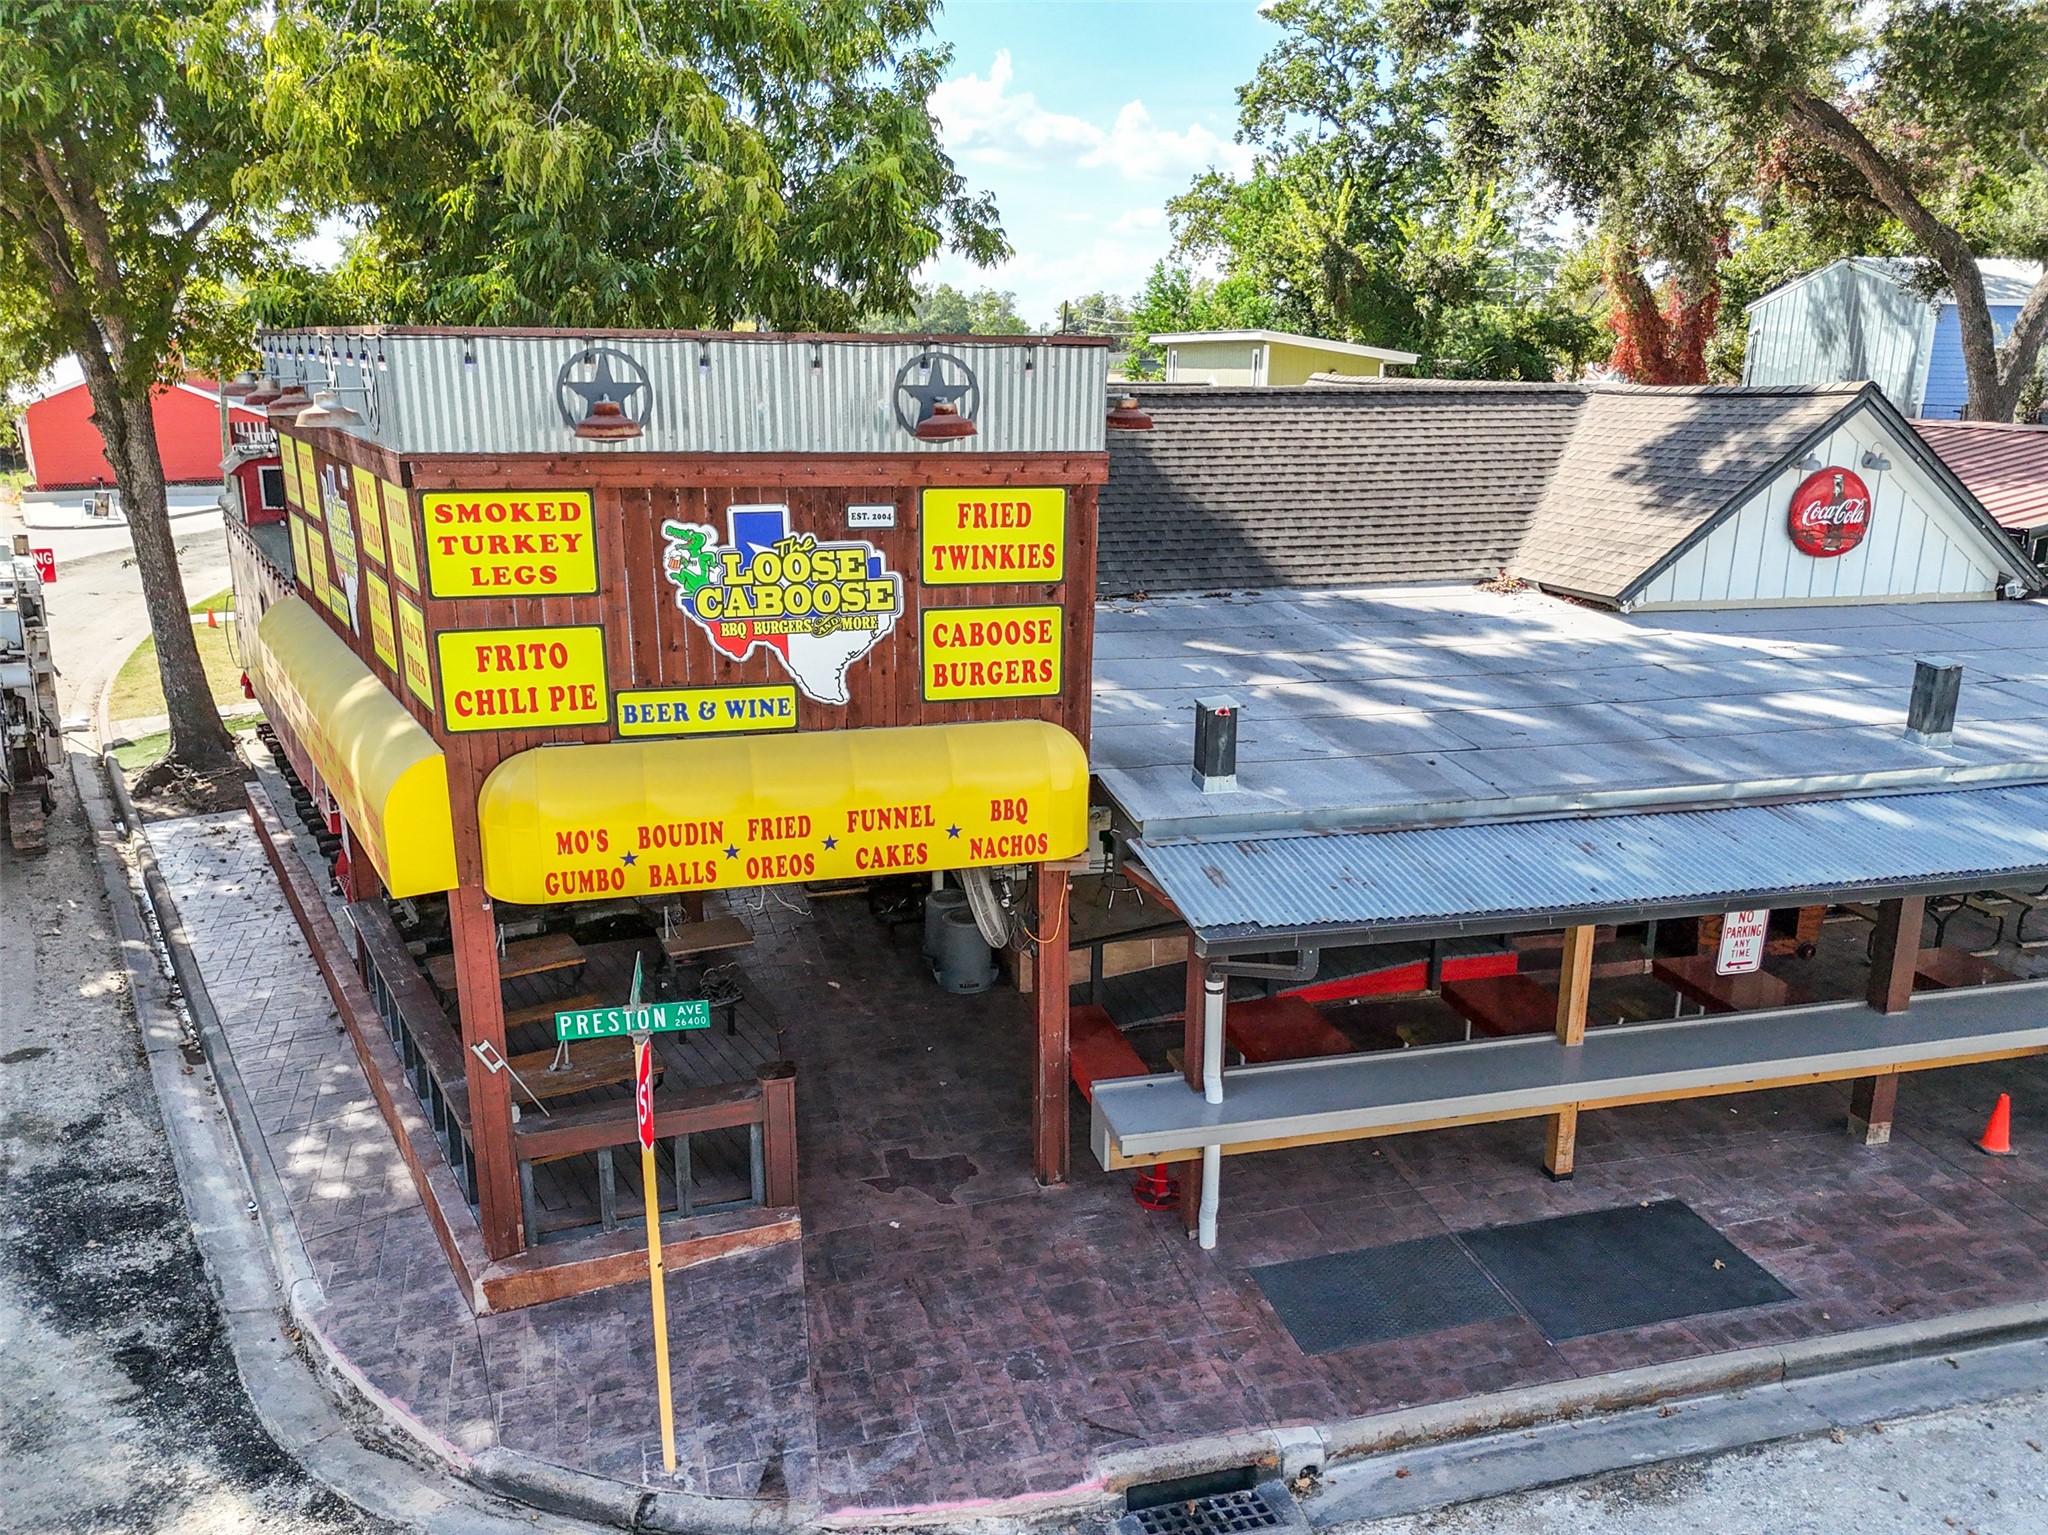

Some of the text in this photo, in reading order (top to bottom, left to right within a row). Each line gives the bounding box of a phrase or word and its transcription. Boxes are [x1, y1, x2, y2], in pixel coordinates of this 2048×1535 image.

[434, 501, 582, 524] SMOKED
[851, 512, 892, 521] EST. 2004
[957, 502, 1032, 529] FRIED
[437, 533, 583, 556] TURKEY
[773, 536, 815, 557] The
[932, 543, 1056, 571] TWINKIES
[471, 565, 558, 587] LEGS
[721, 549, 867, 586] LOOSE
[696, 579, 896, 618] CABOOSE
[402, 614, 424, 650] CAJUN
[720, 615, 879, 639] BBQ BURGERS AND MORE
[932, 619, 1053, 648] CABOOSE
[407, 651, 427, 687] FRIES
[475, 642, 568, 673] FRITO
[932, 659, 1053, 688] BURGERS
[454, 684, 598, 717] CHILI PIE
[622, 697, 792, 724] BEER & WINE
[847, 804, 936, 833] FUNNEL
[990, 798, 1028, 825] BBQ
[555, 828, 609, 856] MO'S
[637, 821, 724, 850] BOUDIN
[747, 815, 811, 842] FRIED
[855, 842, 929, 870] CAKES
[969, 832, 1048, 860] NACHOS
[649, 860, 717, 888] BALLS
[746, 853, 815, 880] OREOS
[545, 867, 625, 896] GUMBO
[1738, 910, 1755, 924] NO
[1725, 924, 1763, 939] PARKING
[1733, 939, 1750, 949] ANY
[1731, 948, 1751, 958] TIME
[559, 1004, 703, 1037] PRESTON AVE
[675, 1016, 706, 1027] 26400
